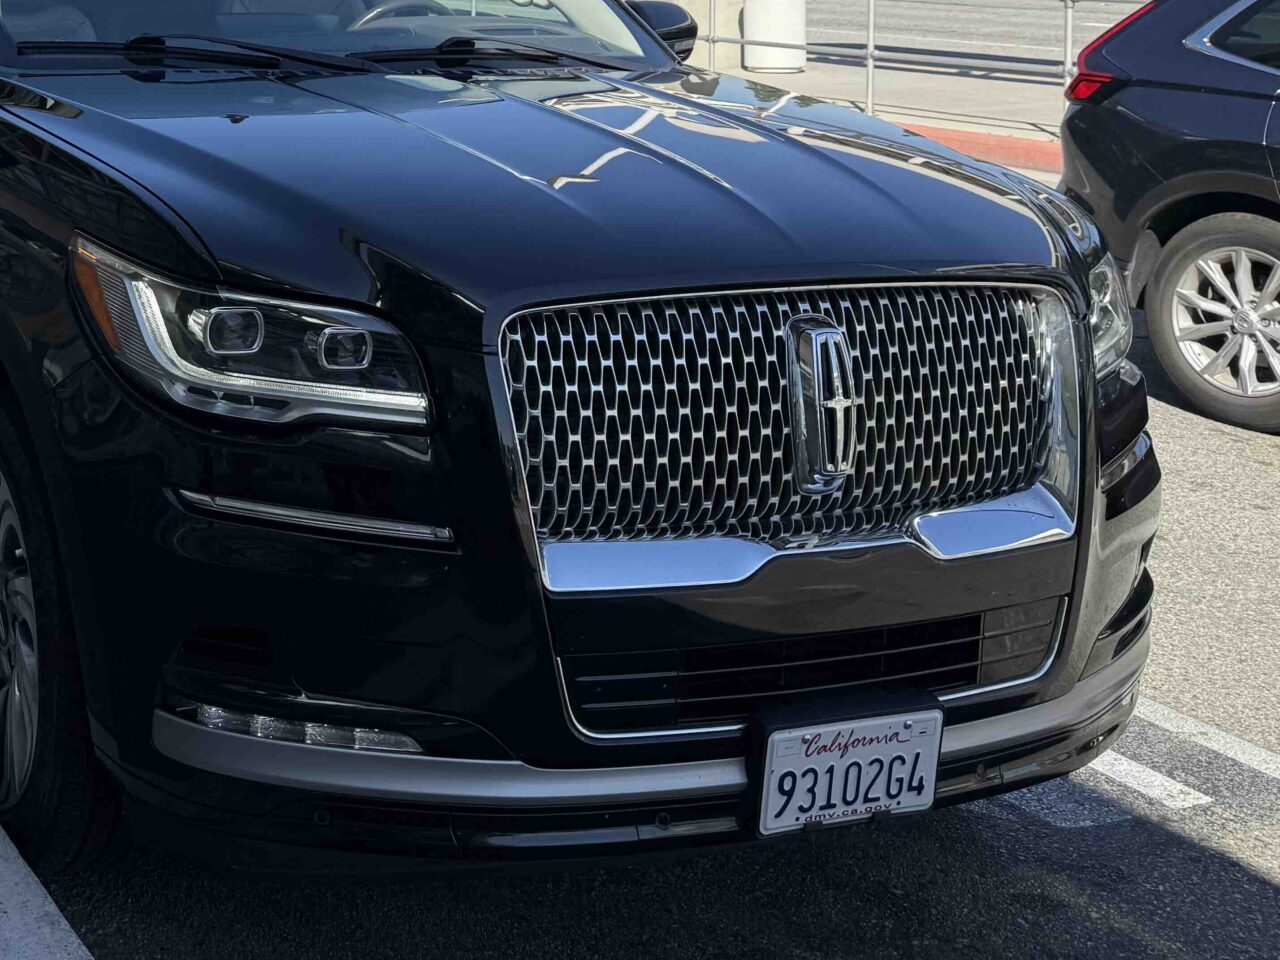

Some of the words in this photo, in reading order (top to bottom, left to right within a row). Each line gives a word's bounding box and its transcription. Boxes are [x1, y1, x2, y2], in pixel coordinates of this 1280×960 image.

[804, 729, 911, 759] California
[774, 751, 925, 819] 93102G4
[804, 802, 893, 823] dmv.ca.gov
